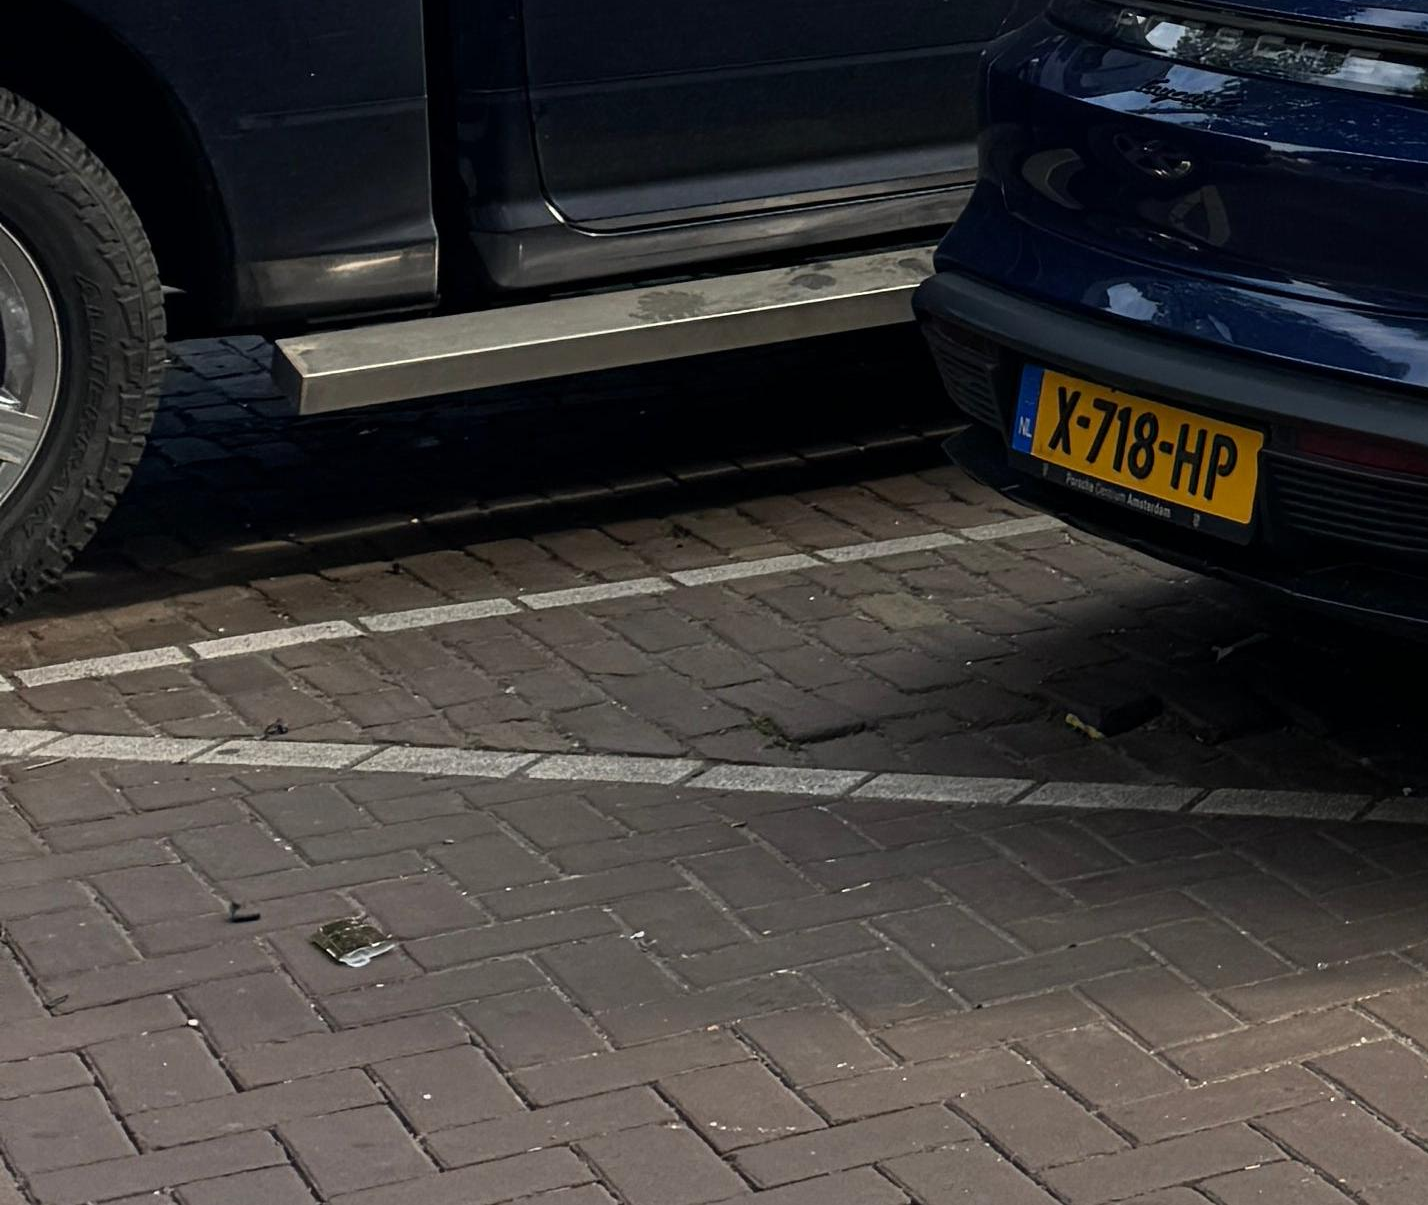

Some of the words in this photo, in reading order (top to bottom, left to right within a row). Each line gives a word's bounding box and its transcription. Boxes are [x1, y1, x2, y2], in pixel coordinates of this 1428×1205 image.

[1018, 416, 1033, 438] NL
[1048, 386, 1238, 501] X-718-HP
[1127, 493, 1172, 518] Amsterdam
